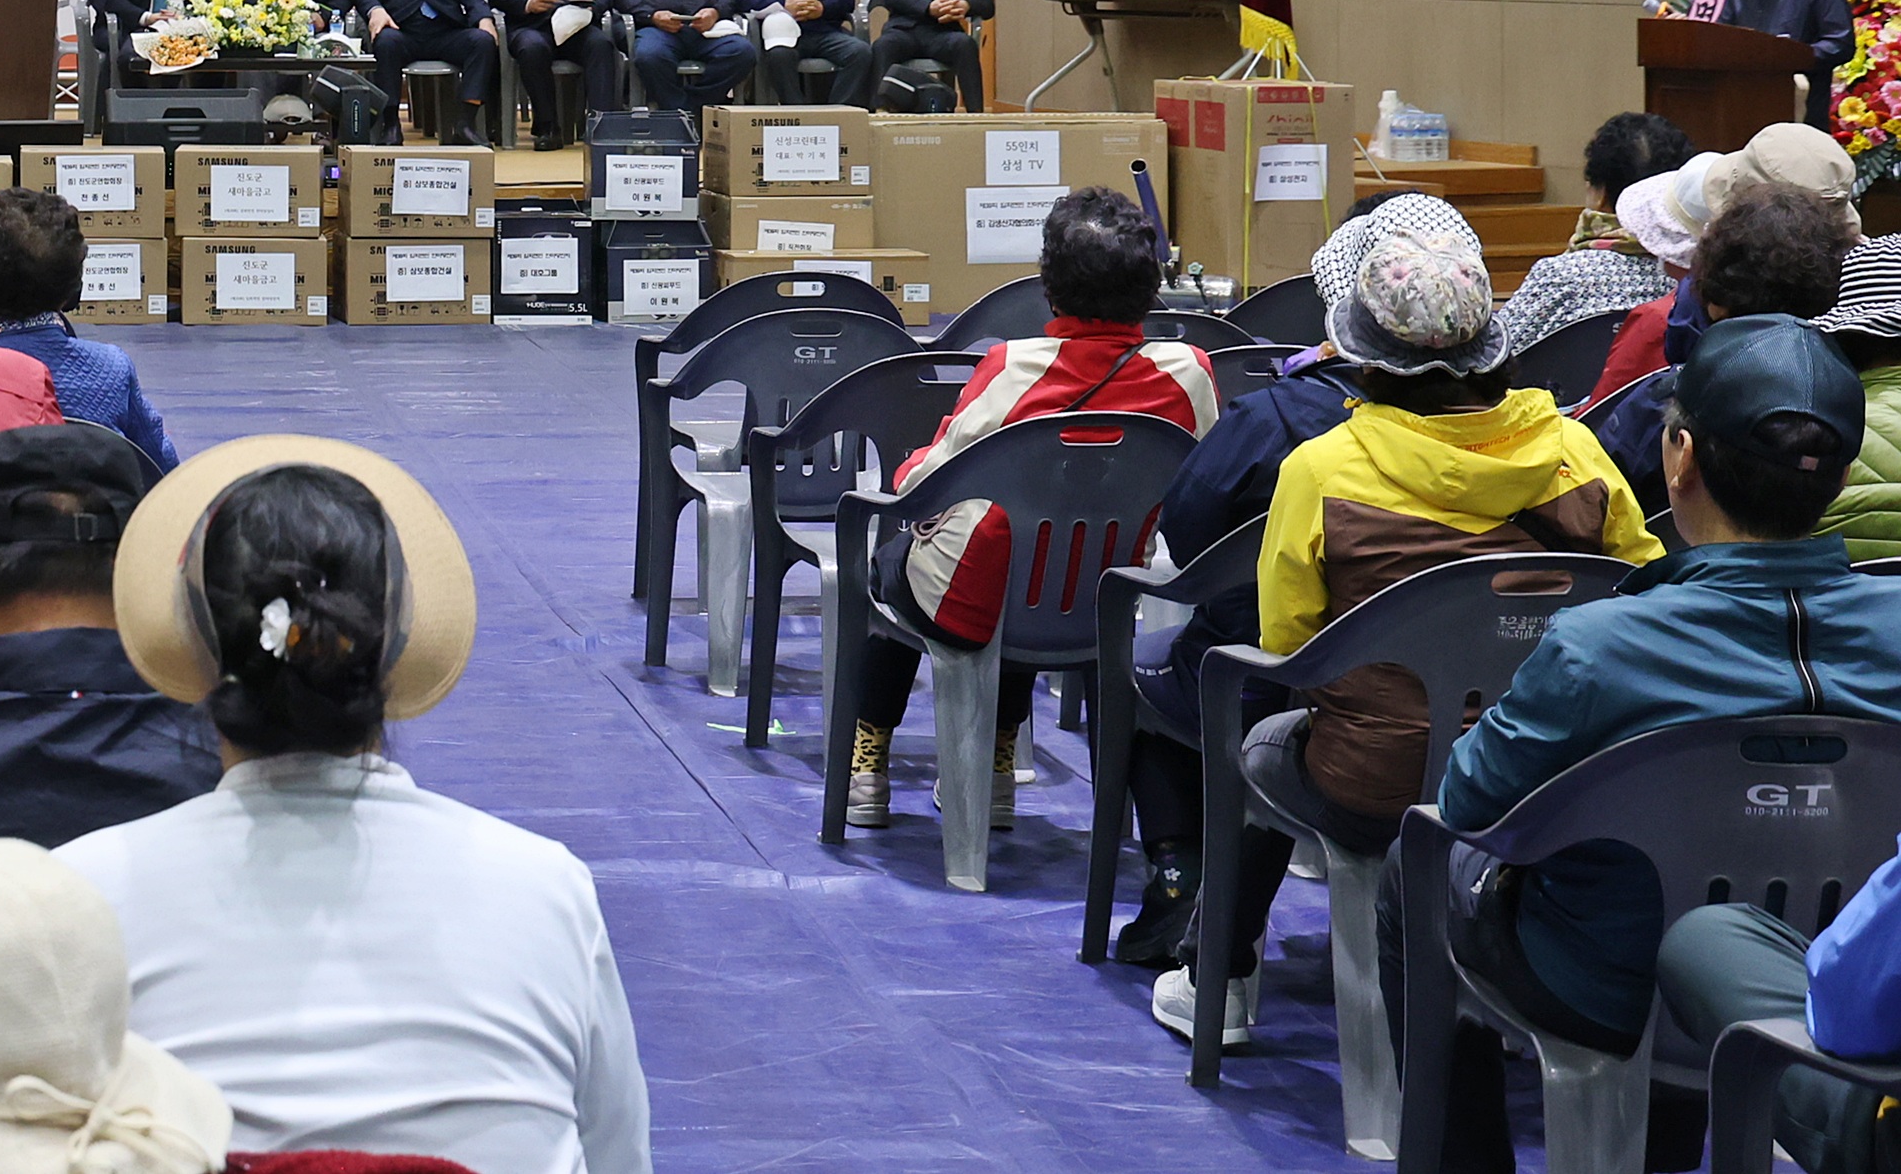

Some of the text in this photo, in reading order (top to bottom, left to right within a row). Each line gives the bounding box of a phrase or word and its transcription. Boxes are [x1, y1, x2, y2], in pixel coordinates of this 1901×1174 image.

[751, 118, 801, 127] SAMSUNG
[775, 136, 827, 146] 신성크린테크
[893, 136, 941, 145] SAMSUNG
[1005, 140, 1038, 153] 55인치
[198, 157, 249, 166] SAMSUNG
[1001, 159, 1044, 172] 삼성 TV
[237, 173, 262, 183] 진도군
[228, 187, 271, 197] 새마을금고
[205, 245, 256, 254] SAMSUNG
[242, 260, 268, 271] 진도군
[233, 275, 277, 285] 새마을금고
[569, 303, 588, 313] 5.5L
[794, 346, 838, 359] GT
[1746, 784, 1832, 806] GT
